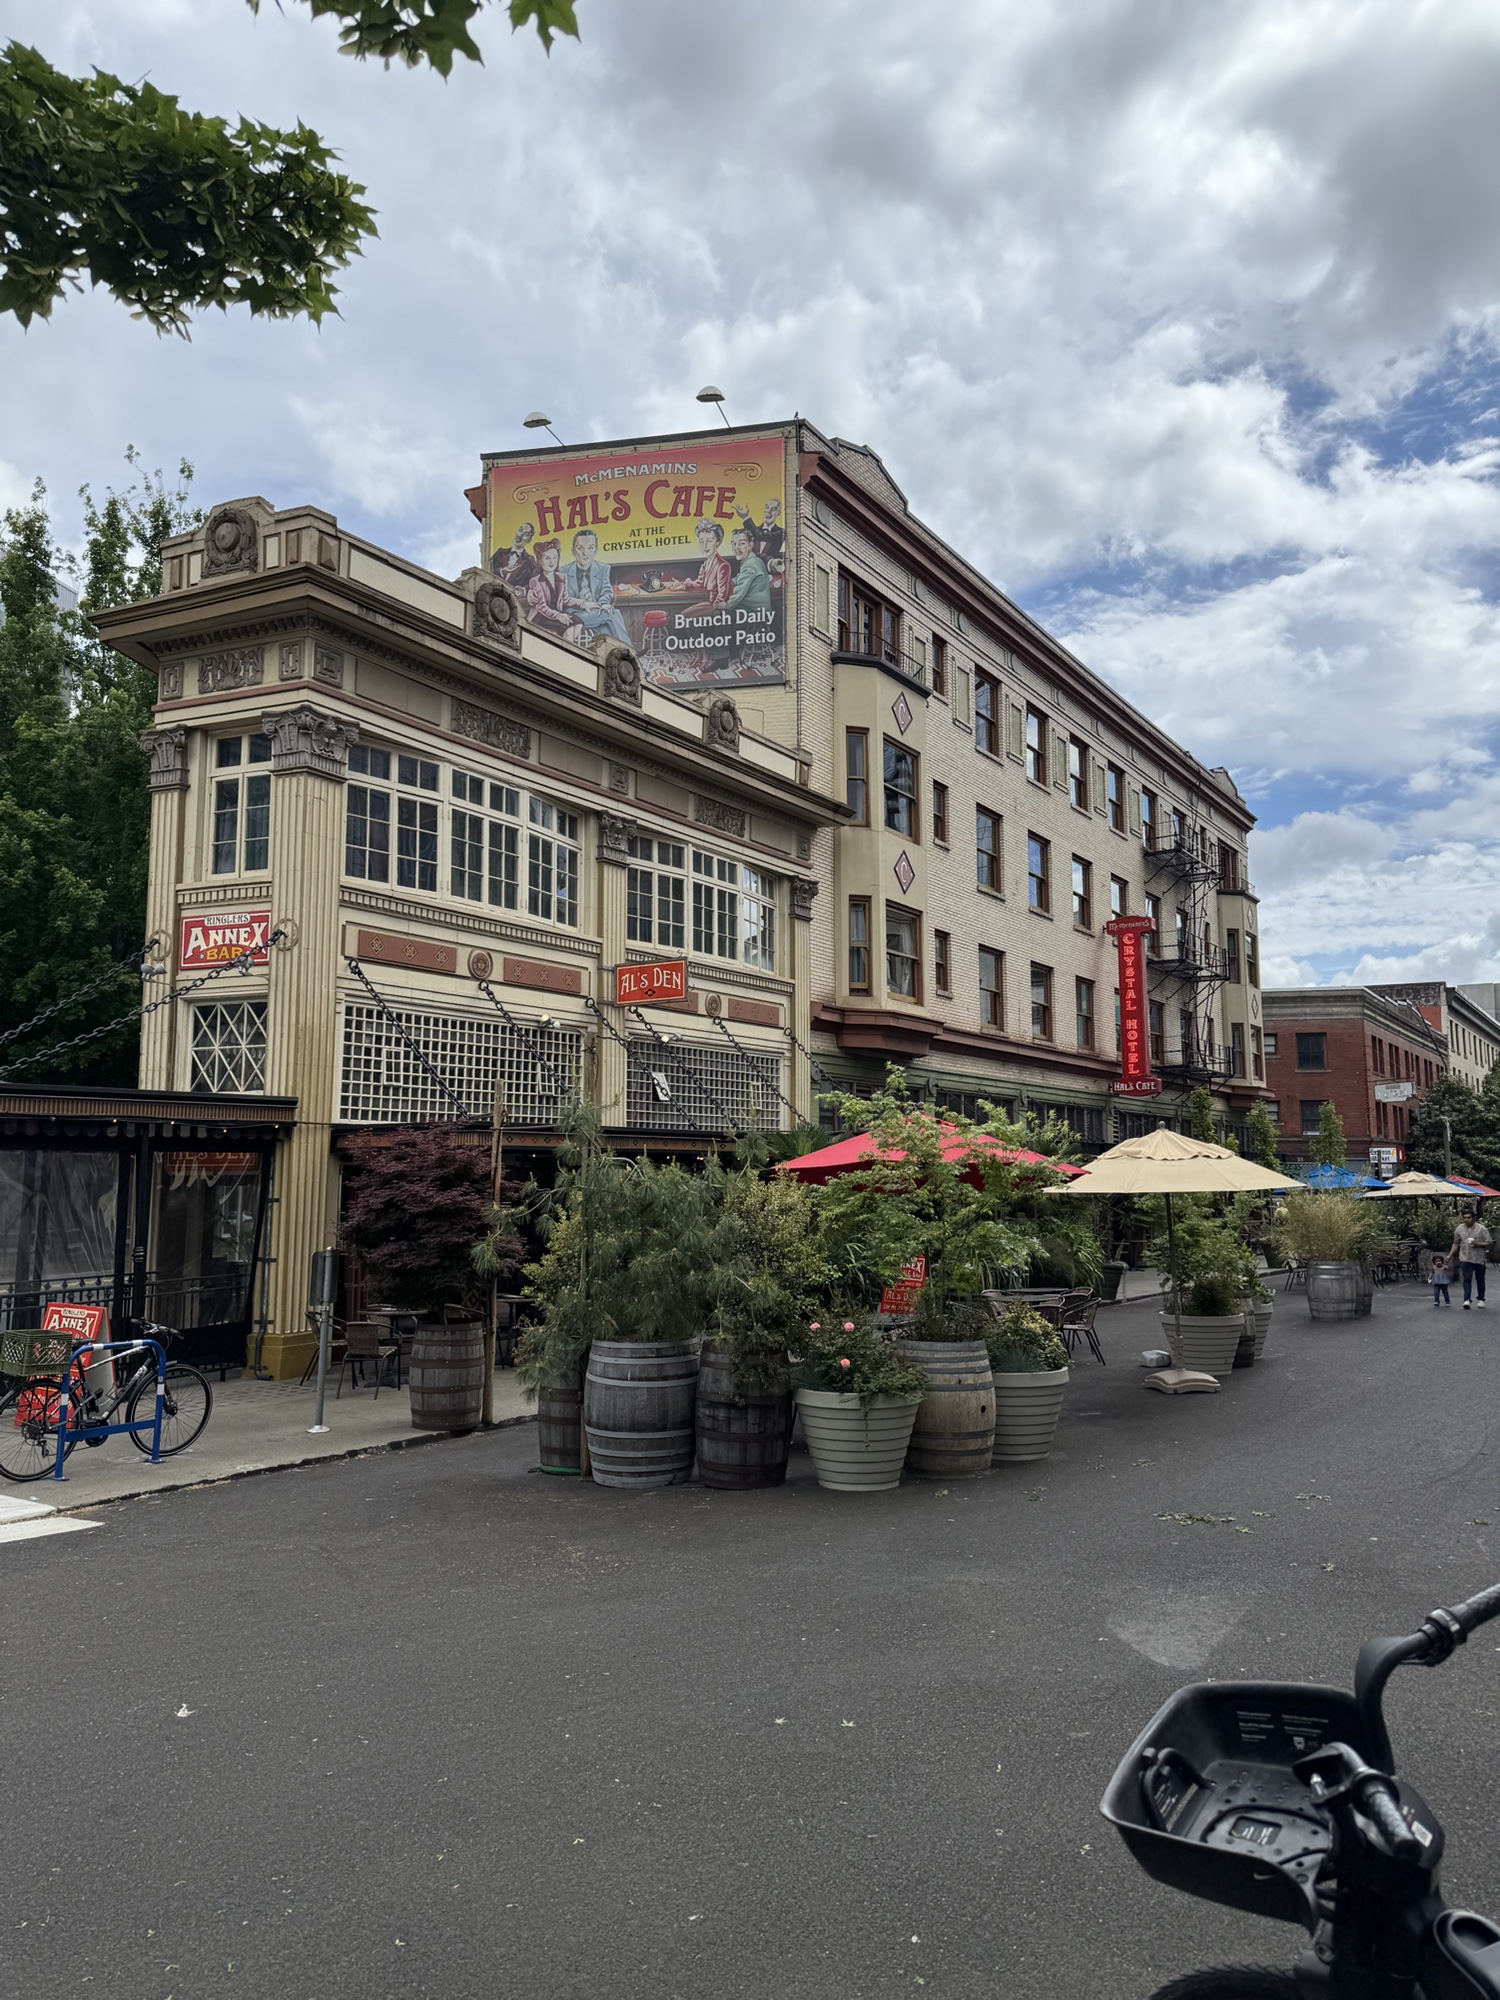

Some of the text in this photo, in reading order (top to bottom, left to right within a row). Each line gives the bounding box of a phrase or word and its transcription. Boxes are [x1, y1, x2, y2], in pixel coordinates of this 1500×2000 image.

[574, 463, 698, 487] McMENAMINS
[534, 479, 737, 536] HAL'S CAFE
[603, 535, 692, 552] CRYSTAL HOTEL
[629, 526, 666, 538] AT THE
[674, 607, 776, 629] Brunch Daily
[665, 628, 776, 651] Outdoor Patio
[206, 914, 249, 925] RINGLERS
[184, 922, 268, 959] ANNEX
[206, 946, 244, 961] BAR
[620, 967, 682, 996] AL'S DEN
[1122, 933, 1140, 1074] CRYSTAL HOTEL
[1135, 1081, 1156, 1091] CAFE
[47, 1314, 95, 1339] ANNEX
